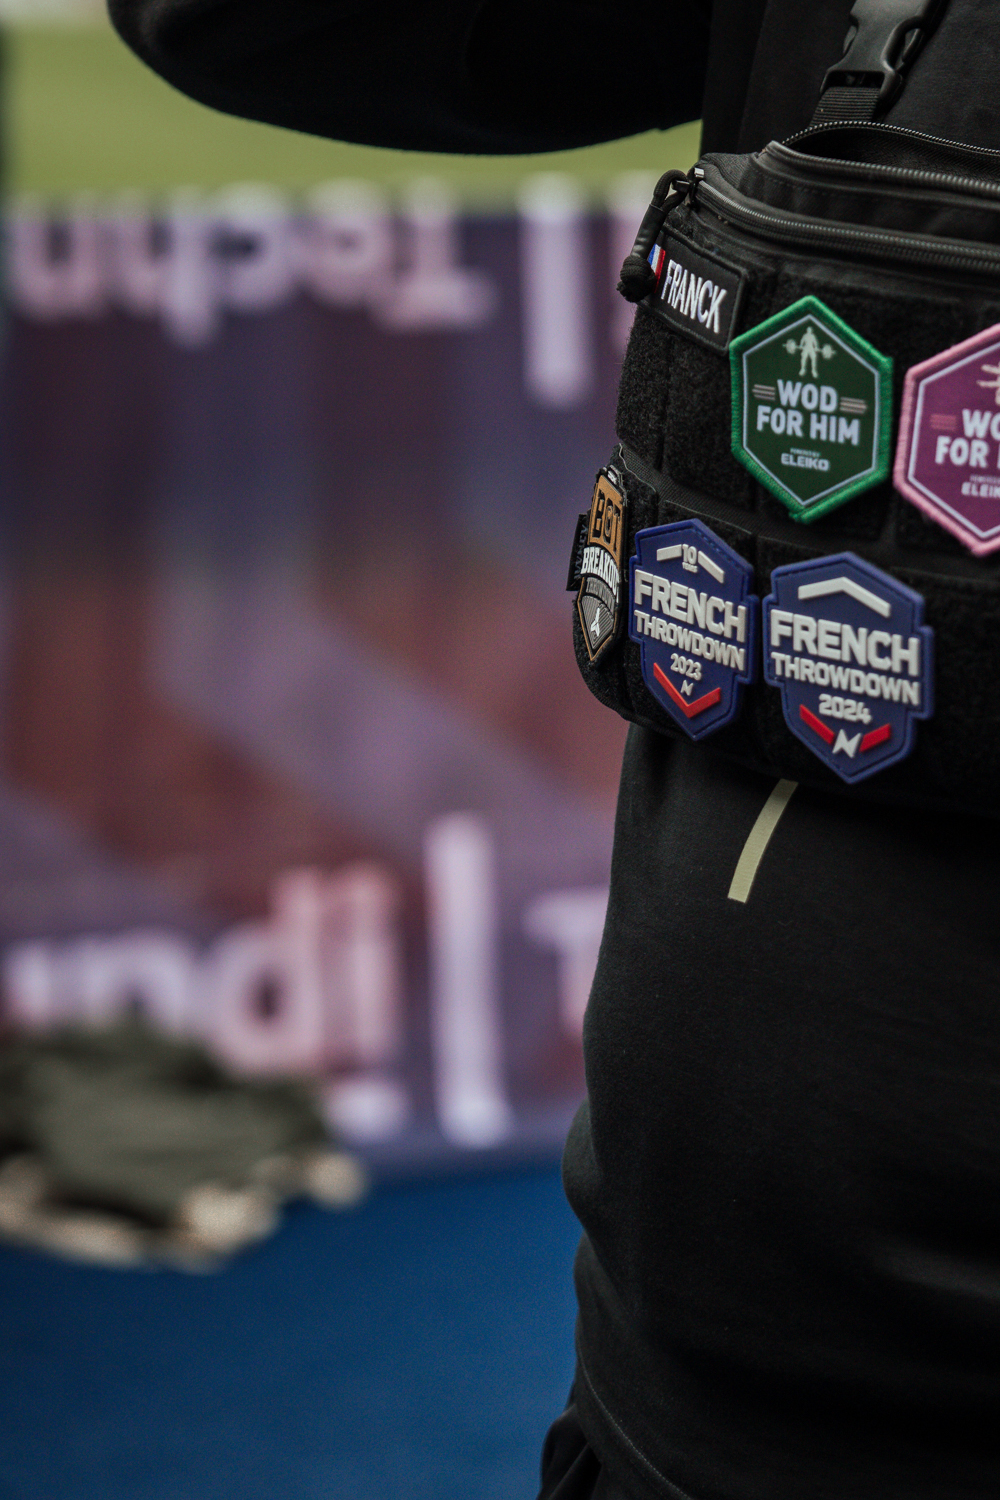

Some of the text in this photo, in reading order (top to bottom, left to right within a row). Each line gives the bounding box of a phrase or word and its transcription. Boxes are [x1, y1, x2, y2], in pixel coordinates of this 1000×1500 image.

[661, 259, 727, 334] FRANCK
[777, 379, 838, 413] WOD
[756, 405, 860, 445] FOR HIM
[781, 452, 830, 472] ELEIKO
[935, 436, 989, 469] FOR
[682, 543, 697, 565] 10
[635, 569, 747, 643] FRENCH
[634, 610, 745, 672] THROWDOWN
[771, 609, 920, 677] FRENCH
[670, 653, 703, 680] 2023
[771, 651, 920, 706] THROWDOWN
[818, 693, 872, 725] 2024
